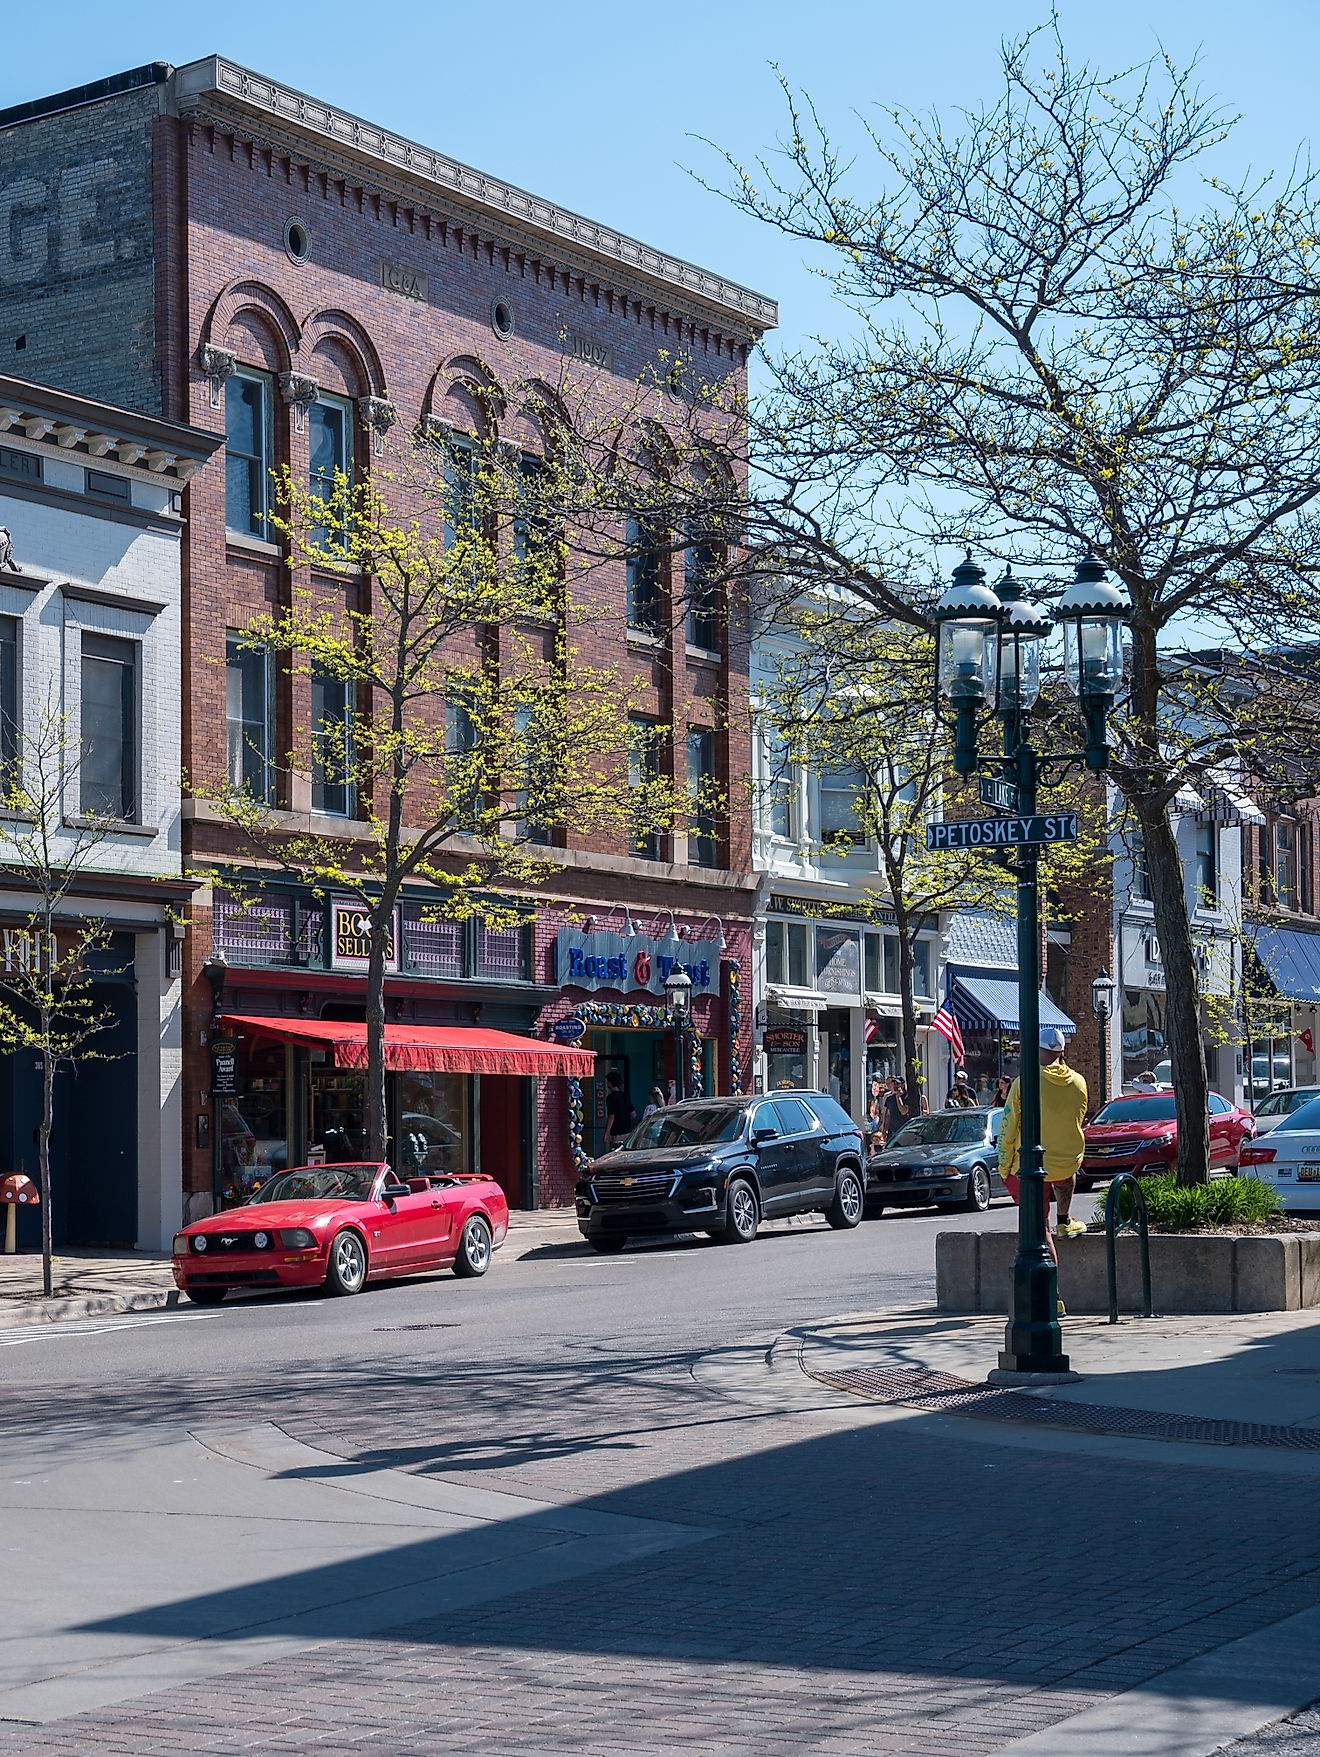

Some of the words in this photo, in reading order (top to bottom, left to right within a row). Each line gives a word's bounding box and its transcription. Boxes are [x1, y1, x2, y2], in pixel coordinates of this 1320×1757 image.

[994, 782, 1009, 807] LAKE
[935, 819, 1033, 848] PETOSKEY
[1044, 816, 1069, 839] ST
[337, 937, 393, 959] SELLS
[569, 947, 628, 981] Roast
[634, 949, 652, 986] &
[656, 954, 711, 987] Tast
[766, 1032, 805, 1043] SHORTER
[782, 1040, 800, 1048] SON
